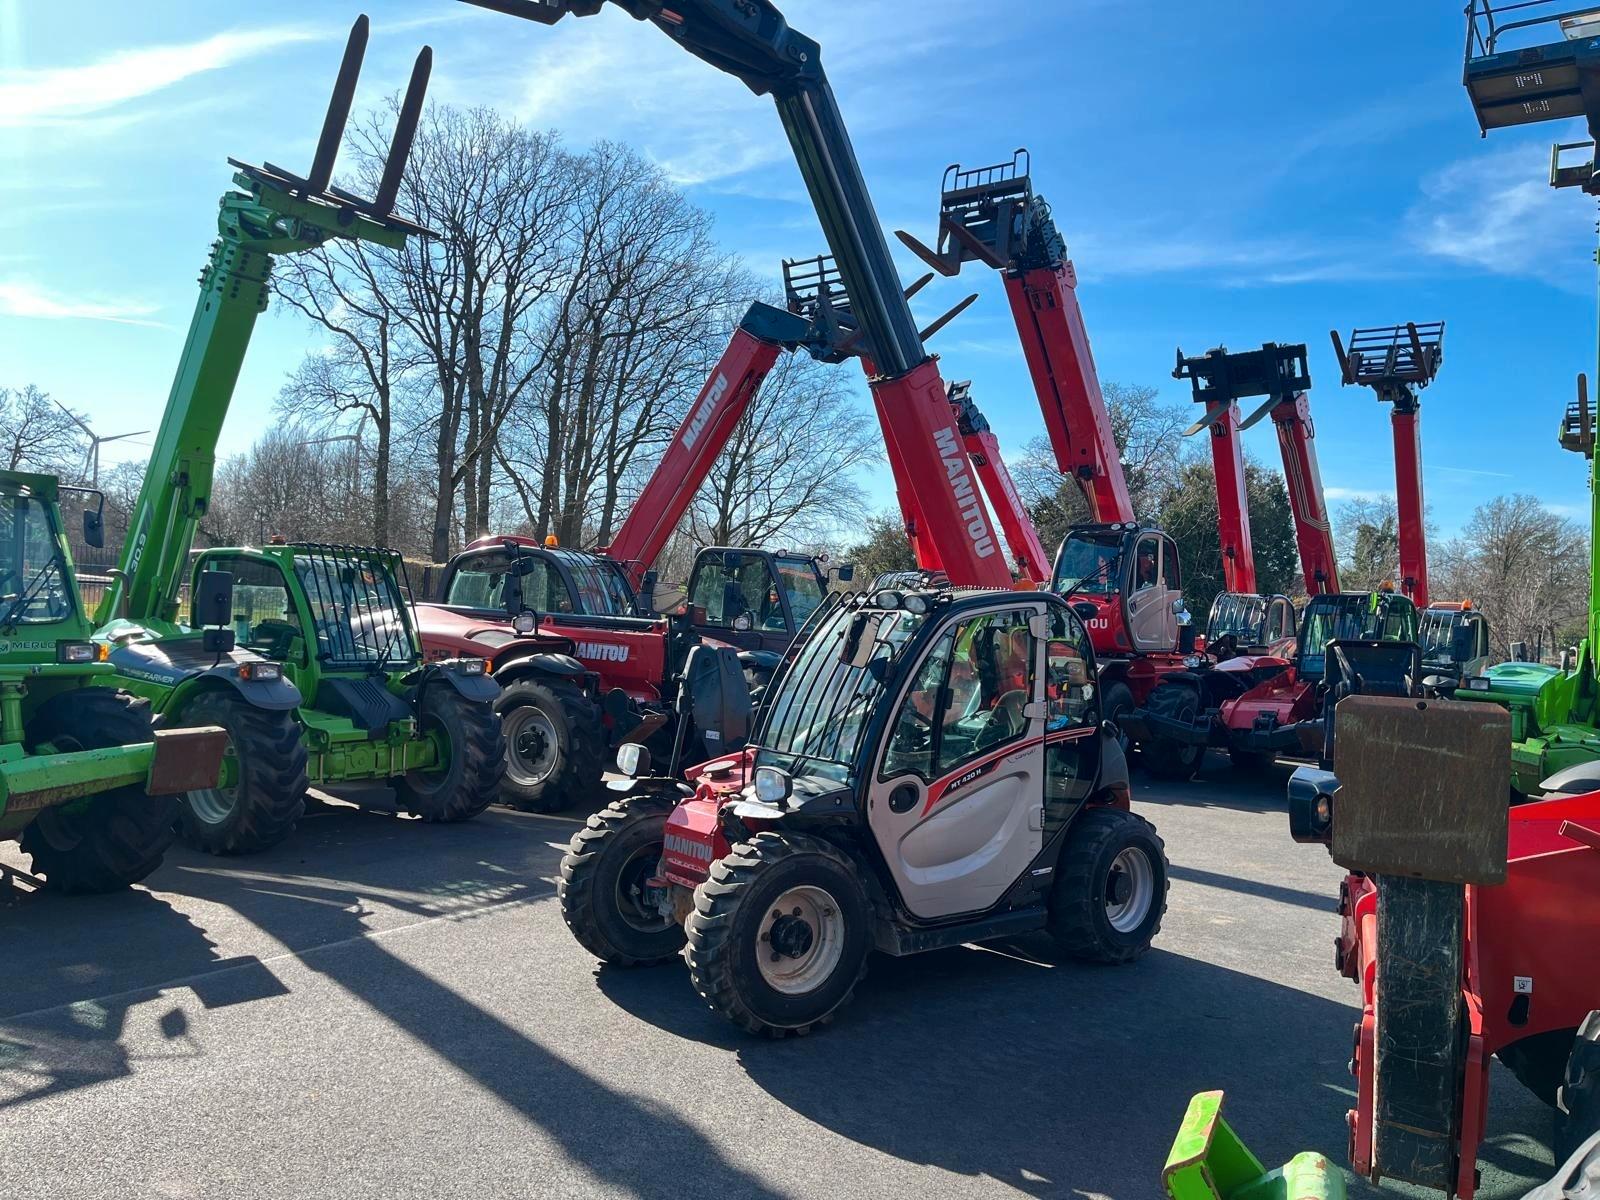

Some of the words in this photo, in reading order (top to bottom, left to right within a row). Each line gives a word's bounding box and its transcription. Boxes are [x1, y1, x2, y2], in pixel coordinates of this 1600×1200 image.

[681, 371, 728, 451] MANITOU
[933, 427, 995, 558] MANITOU
[12, 640, 56, 649] MERLO
[573, 641, 630, 662] ANITOU
[951, 780, 961, 789] MT
[961, 773, 976, 783] 420
[663, 833, 713, 862] MANITOU
